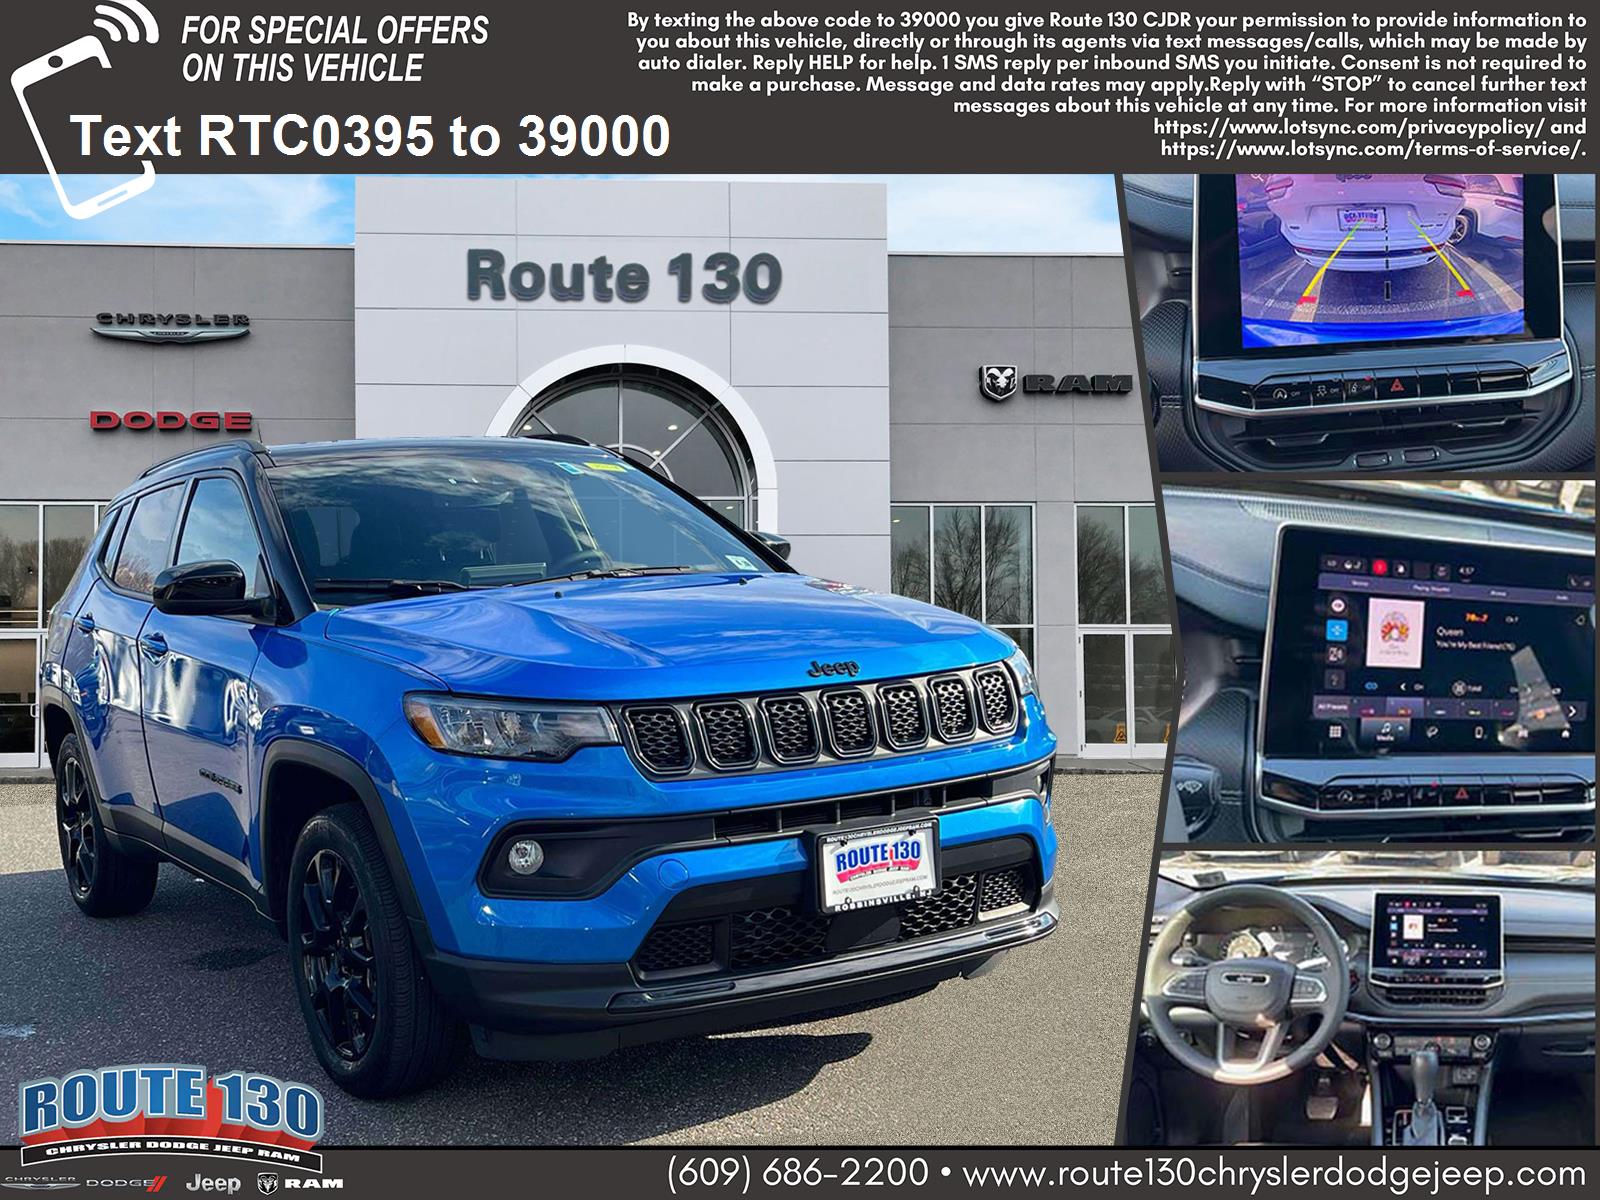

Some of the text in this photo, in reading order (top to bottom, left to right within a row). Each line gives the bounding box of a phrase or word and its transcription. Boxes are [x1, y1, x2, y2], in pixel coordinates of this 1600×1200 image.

[467, 249, 782, 304] Route 130
[96, 312, 250, 326] CHRYSLER
[1023, 375, 1134, 394] RAM
[89, 411, 253, 431] DODGE
[807, 660, 860, 677] Jeep
[835, 841, 921, 872] ROUTE 130
